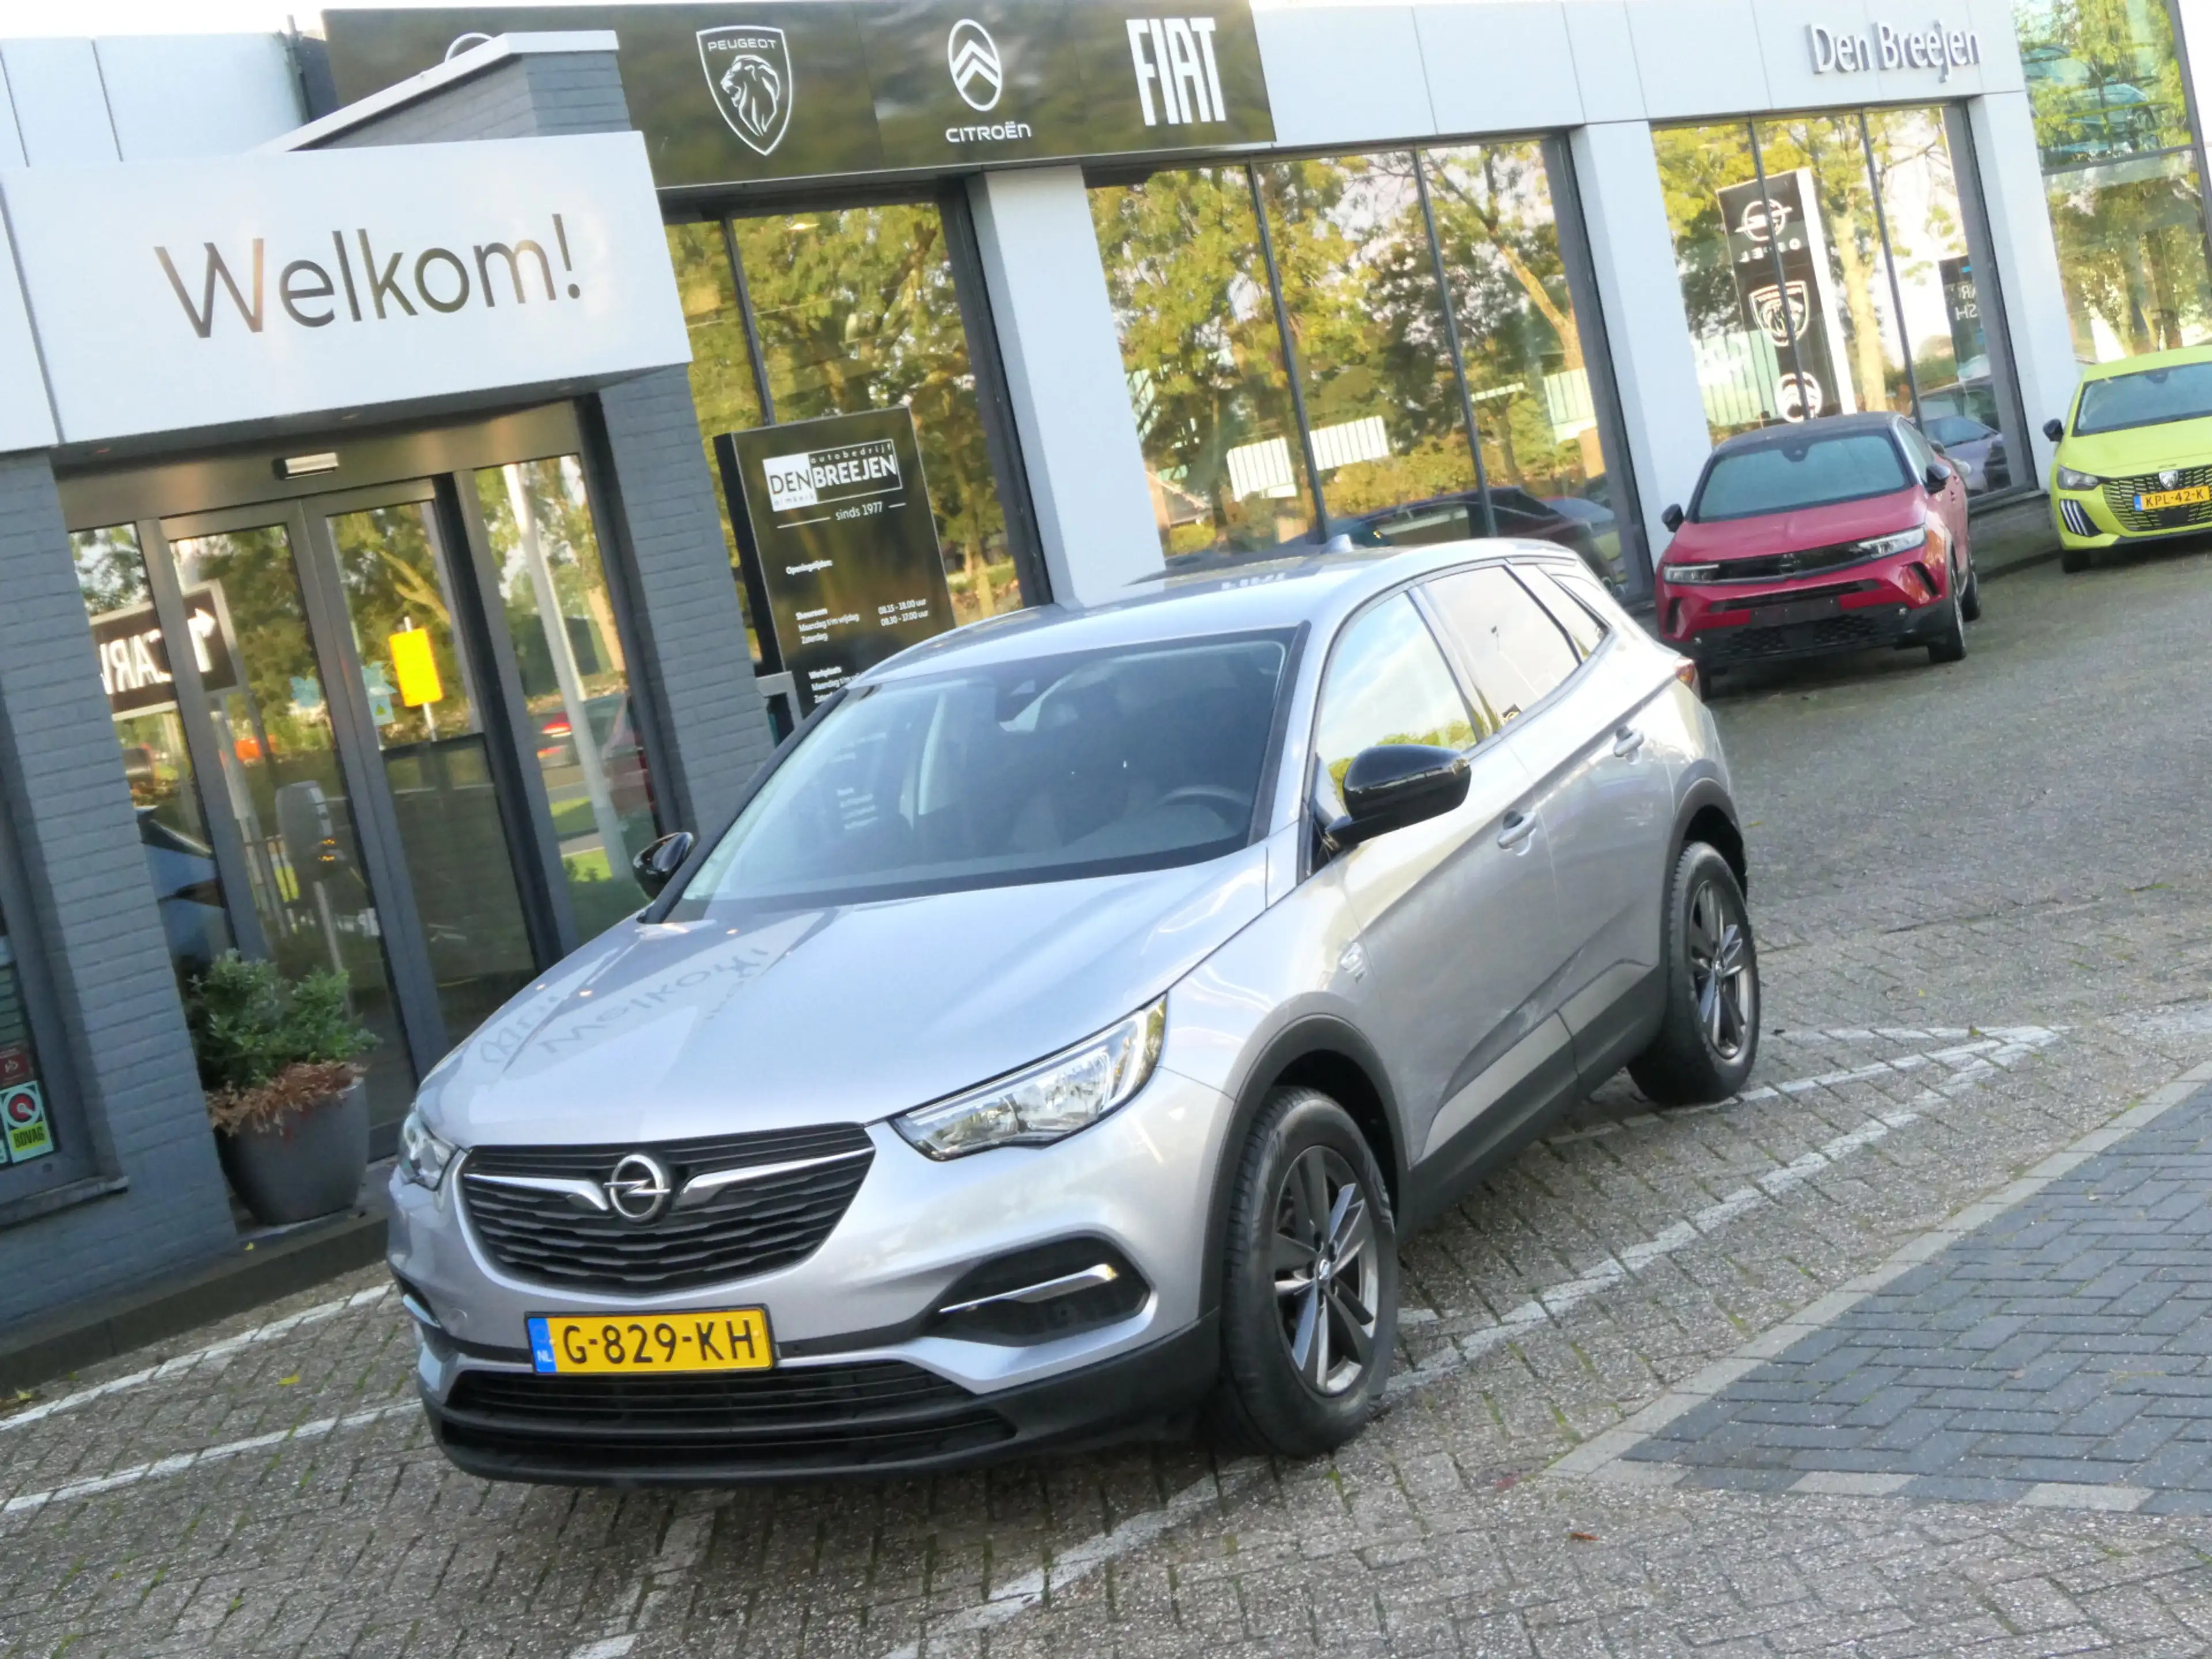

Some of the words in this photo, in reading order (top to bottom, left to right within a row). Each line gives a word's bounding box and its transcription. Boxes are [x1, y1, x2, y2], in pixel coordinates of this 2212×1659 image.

[708, 37, 777, 51] PEUGEOT
[1805, 22, 1873, 74] Den
[1872, 18, 1982, 84] Breejen
[1125, 17, 1227, 127] FIAT
[154, 213, 581, 339] Welkom!
[810, 442, 892, 464] autobedrijf
[769, 469, 813, 495] DEN
[812, 454, 897, 488] BREEJEN
[835, 506, 861, 521] sinds
[862, 501, 883, 516] 1977
[2145, 488, 2204, 507] KPL-42-K
[13, 1126, 45, 1149] BOVAG
[537, 1349, 554, 1362] NL
[562, 1319, 756, 1365] G-829-KH
